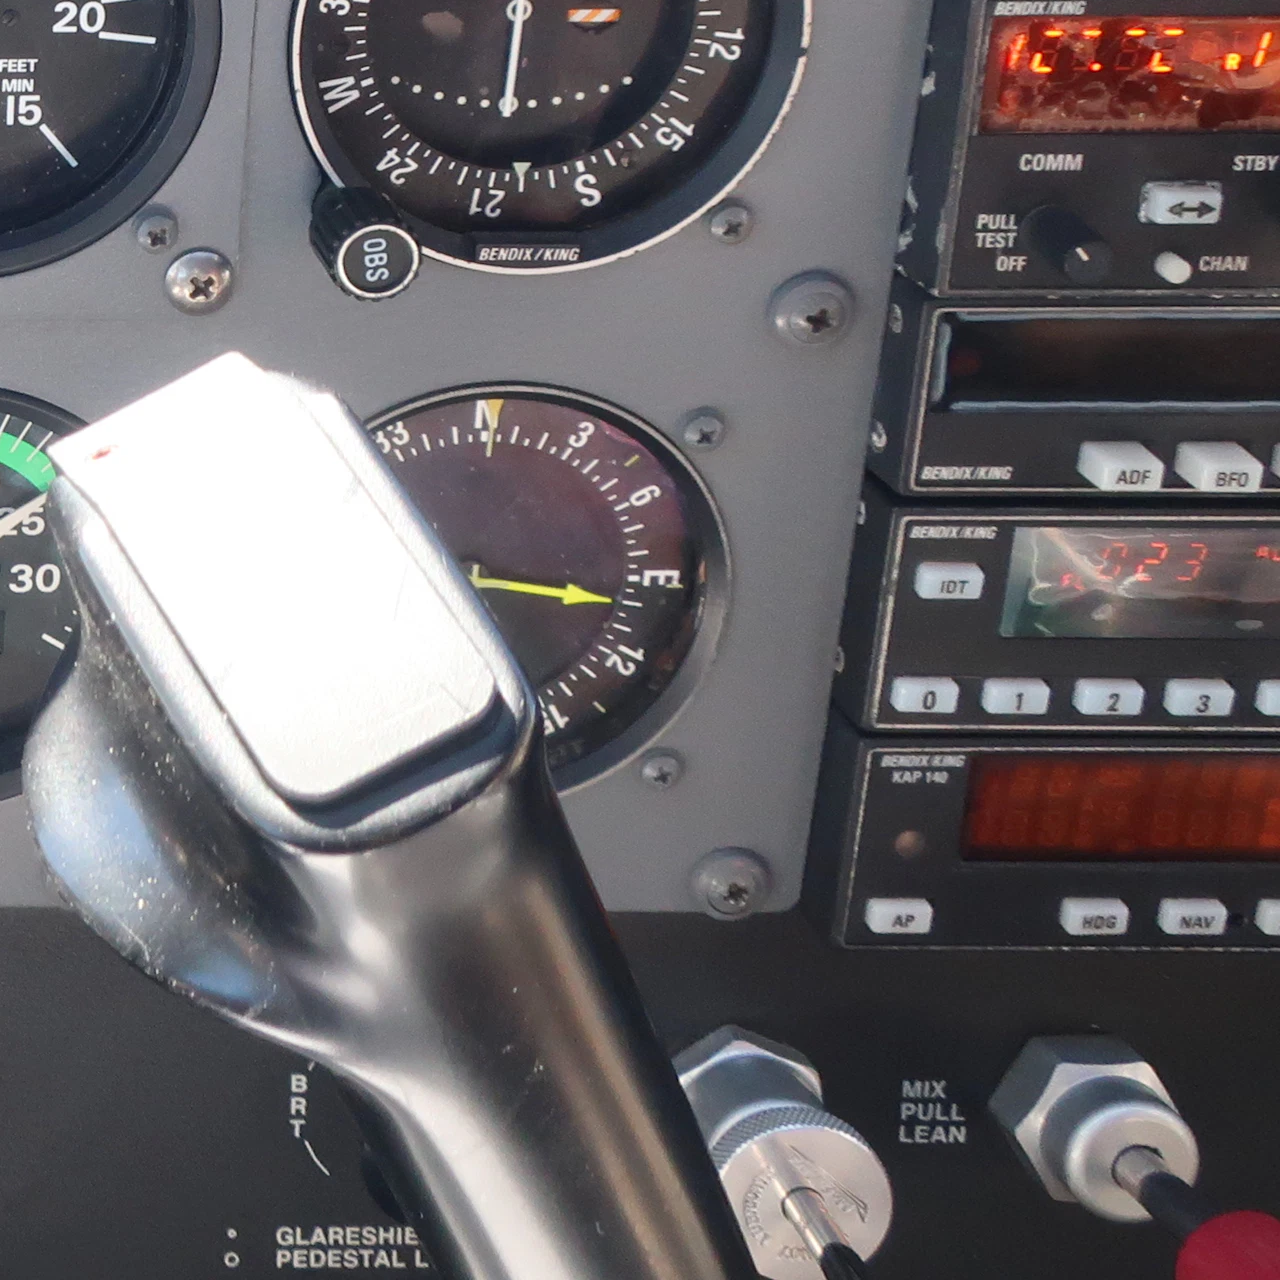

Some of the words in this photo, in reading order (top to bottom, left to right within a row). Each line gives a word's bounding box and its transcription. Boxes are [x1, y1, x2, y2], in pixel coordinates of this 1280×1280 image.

[1, 78, 34, 93] MIN
[1019, 153, 1083, 171] COMM
[362, 237, 390, 282] OBS
[1199, 255, 1248, 272] CHAN
[1115, 469, 1152, 485] ADF
[902, 1080, 946, 1099] MIX
[900, 1102, 965, 1122] PULL
[898, 1125, 967, 1144] LEAN
[276, 1248, 406, 1269] PEDESTAL
